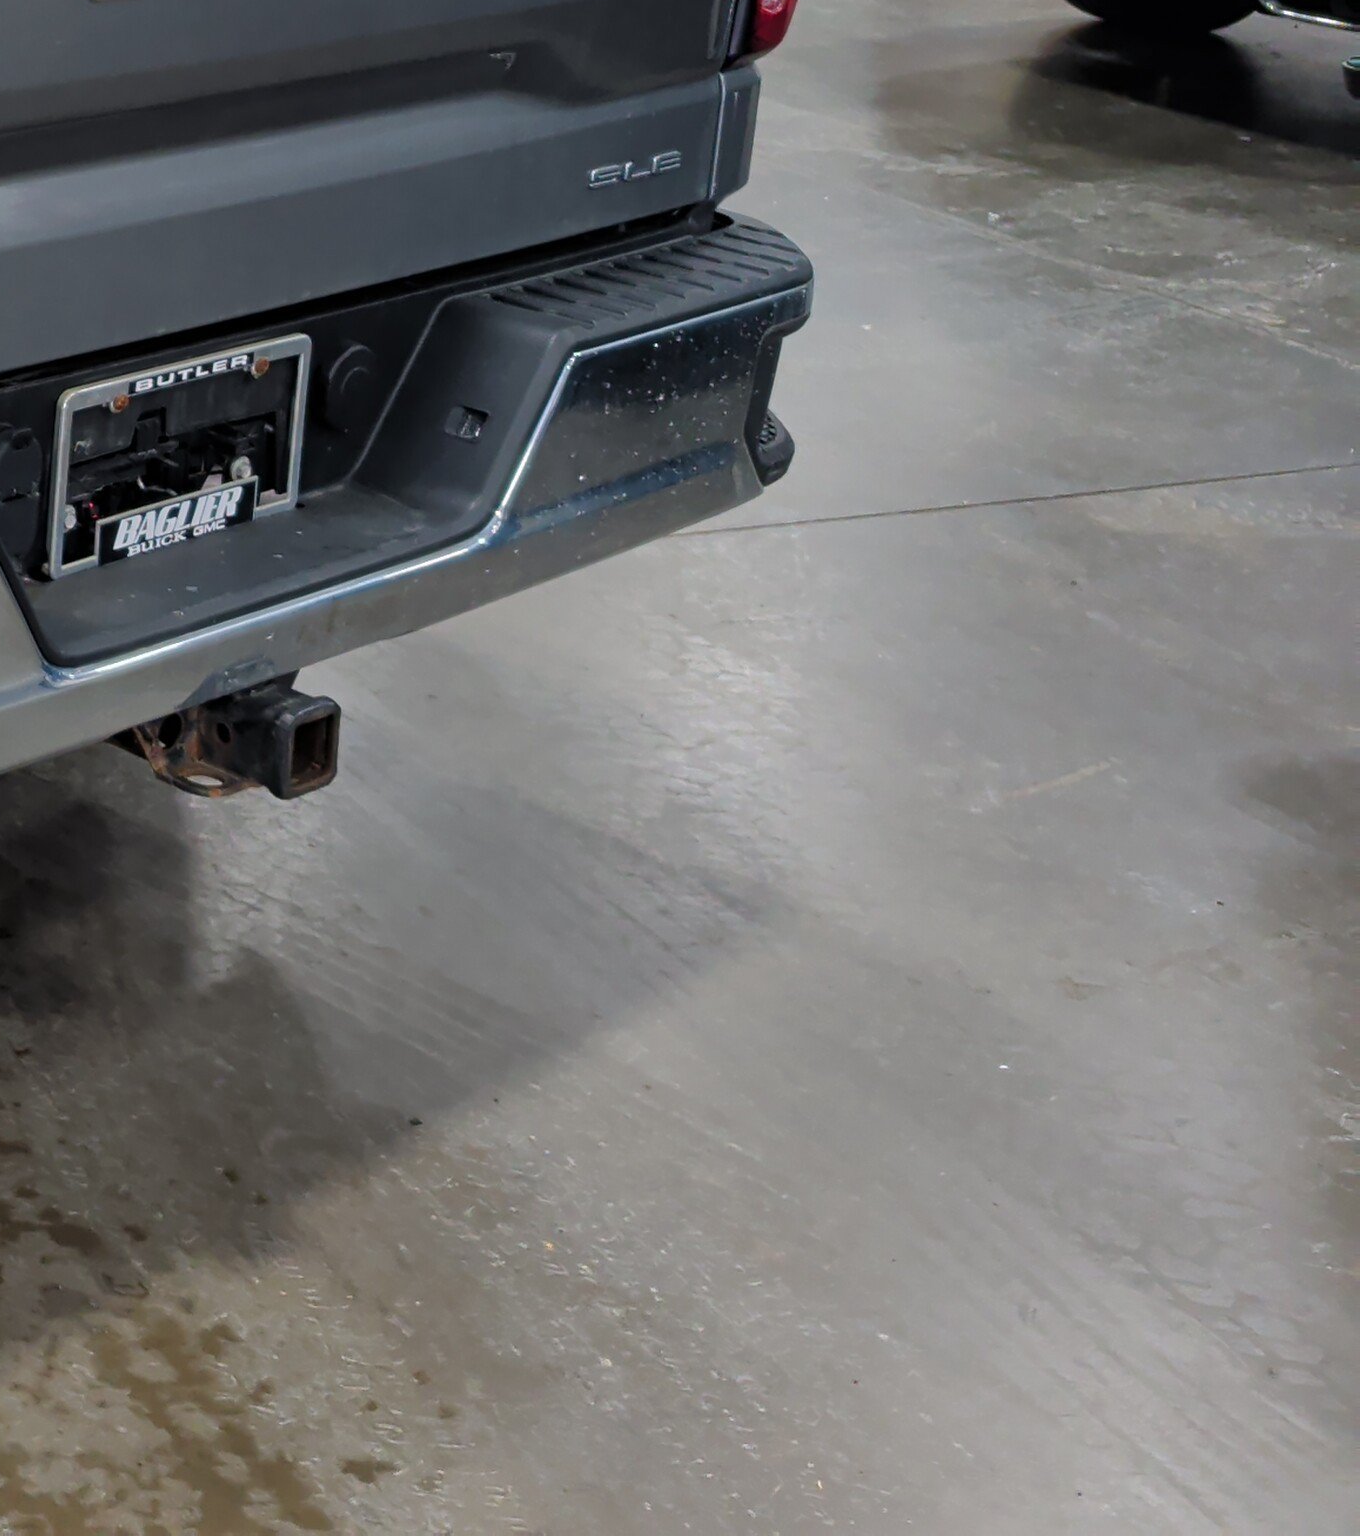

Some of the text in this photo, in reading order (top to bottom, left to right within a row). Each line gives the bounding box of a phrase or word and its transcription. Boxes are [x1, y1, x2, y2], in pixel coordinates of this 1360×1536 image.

[588, 150, 682, 189] SLE
[135, 354, 248, 392] BUTLER
[112, 485, 244, 551] BAGLIER
[127, 519, 226, 558] BUICK GMC
